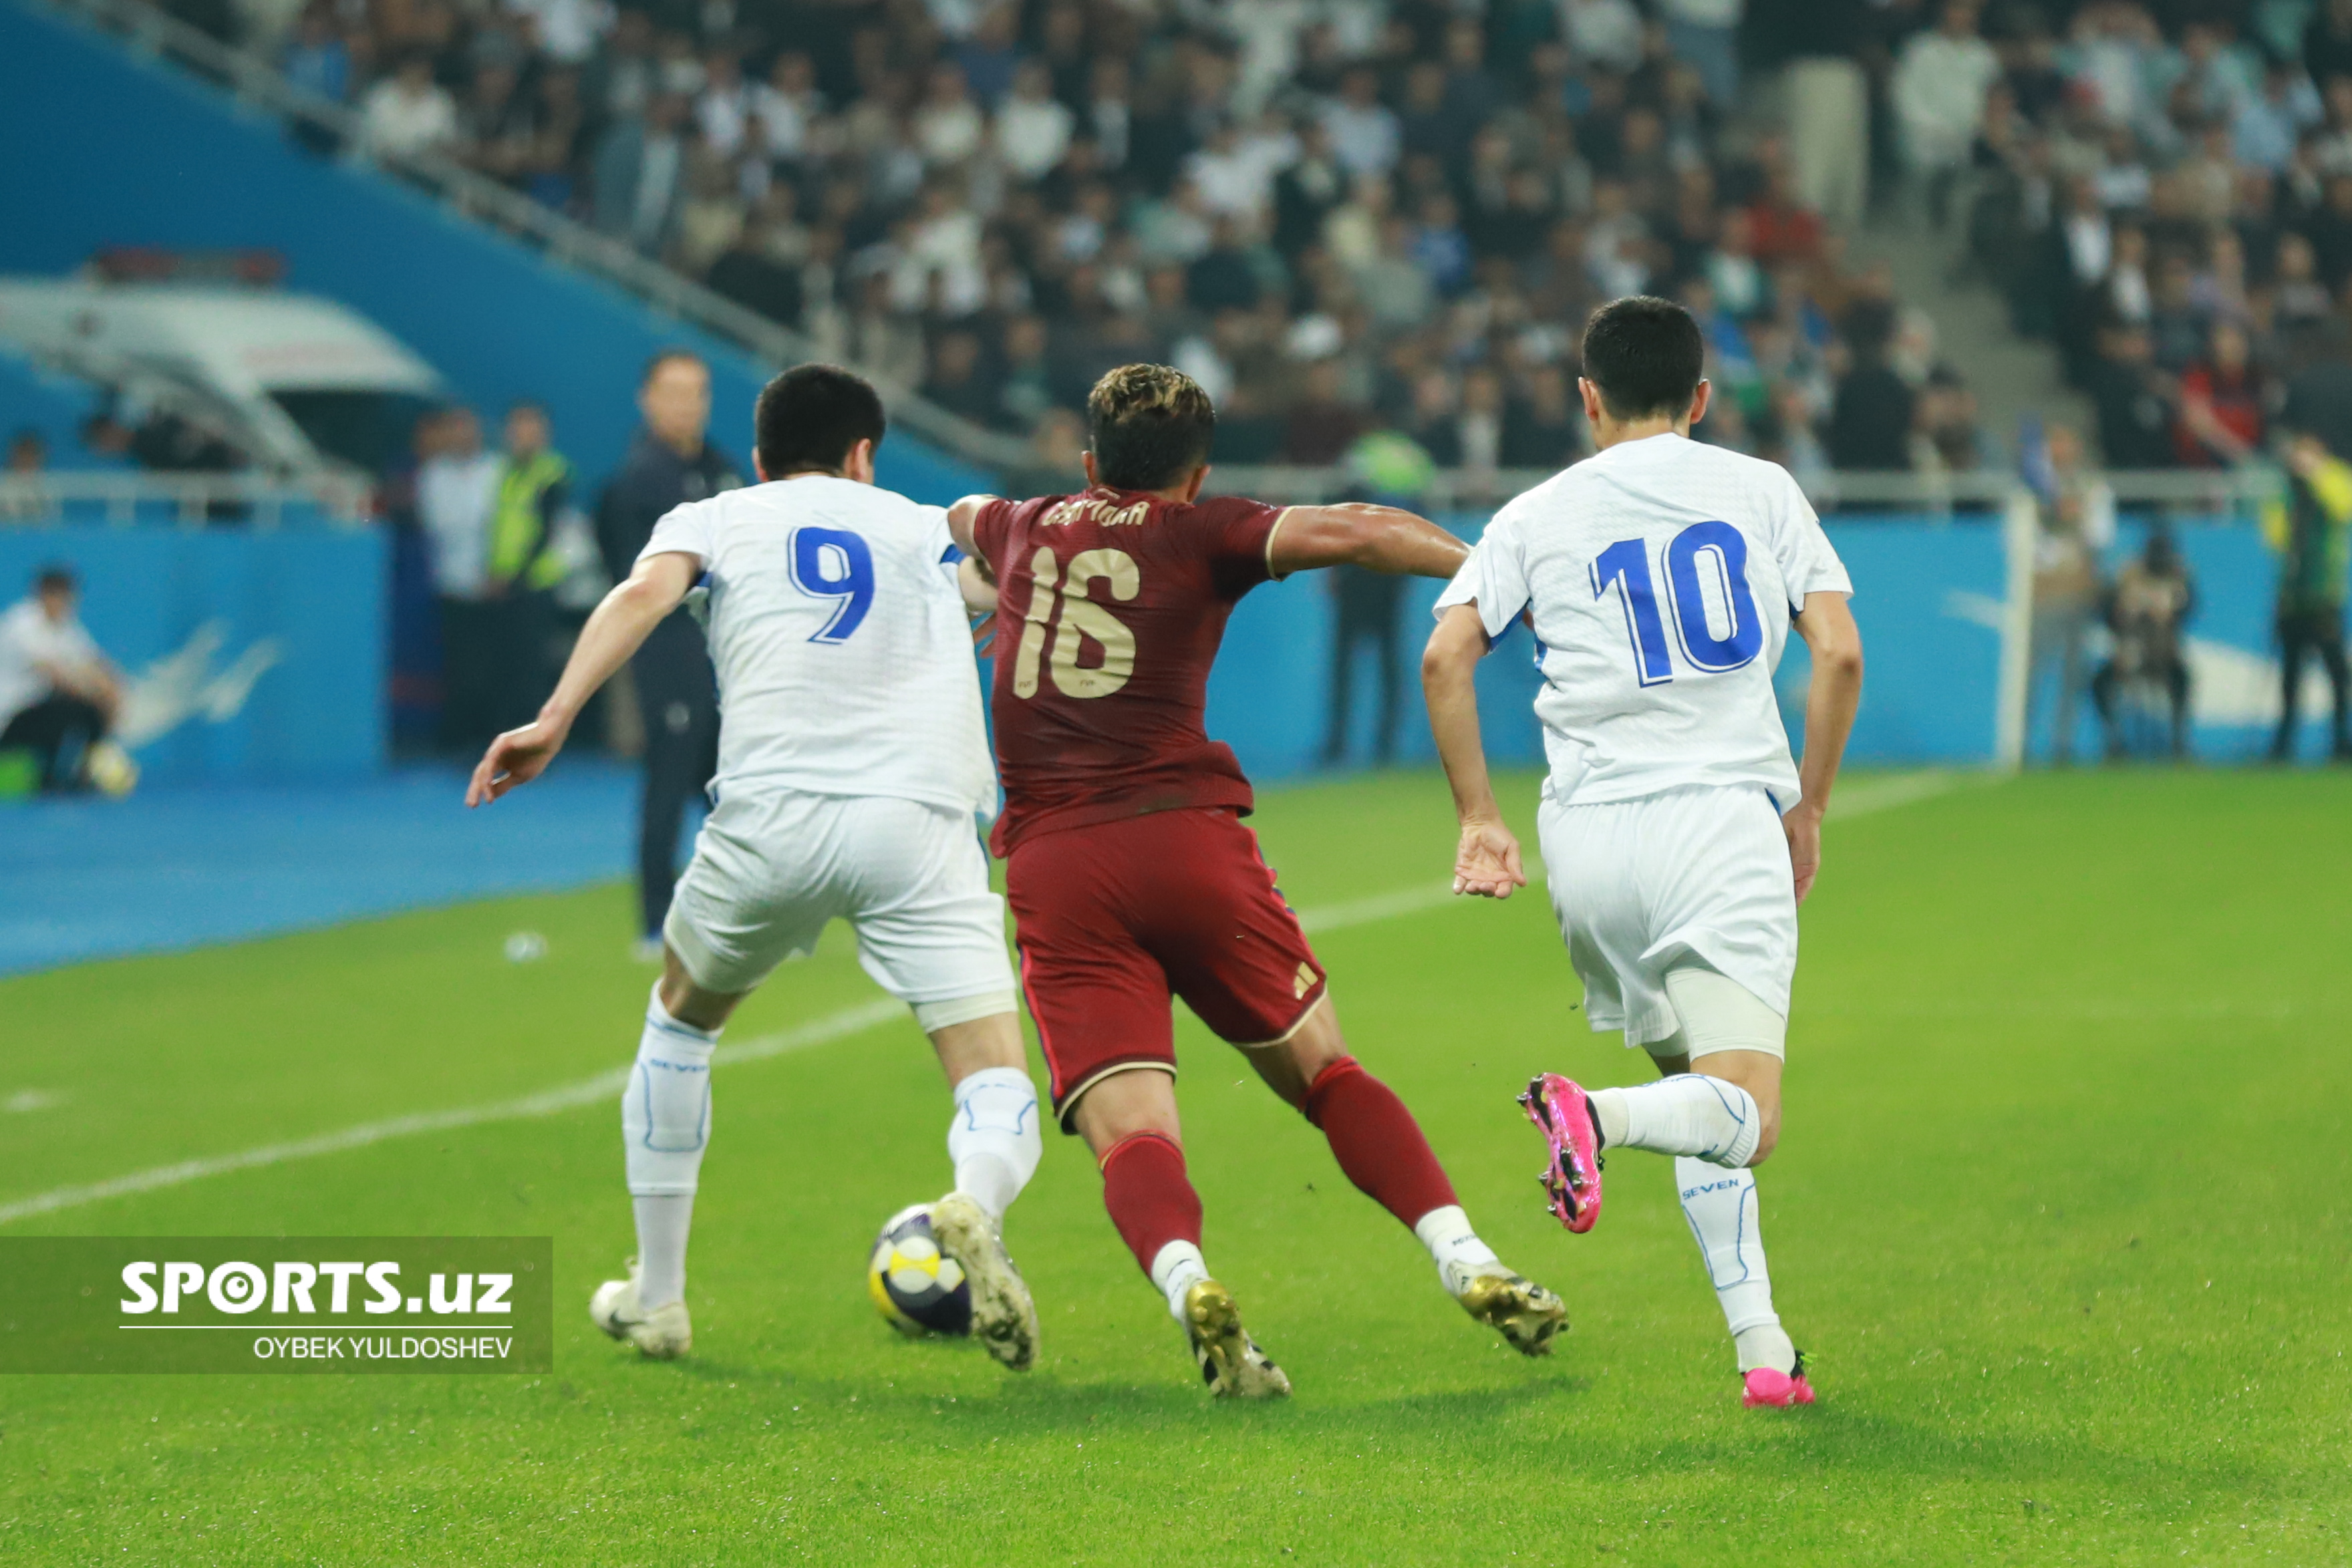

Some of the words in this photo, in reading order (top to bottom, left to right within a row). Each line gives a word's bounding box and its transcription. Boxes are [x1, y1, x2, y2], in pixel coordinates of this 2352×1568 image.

[787, 526, 875, 645] 9
[1013, 546, 1140, 699] 16
[1588, 520, 1763, 688] 10
[1682, 1179, 1739, 1200] SEVEN
